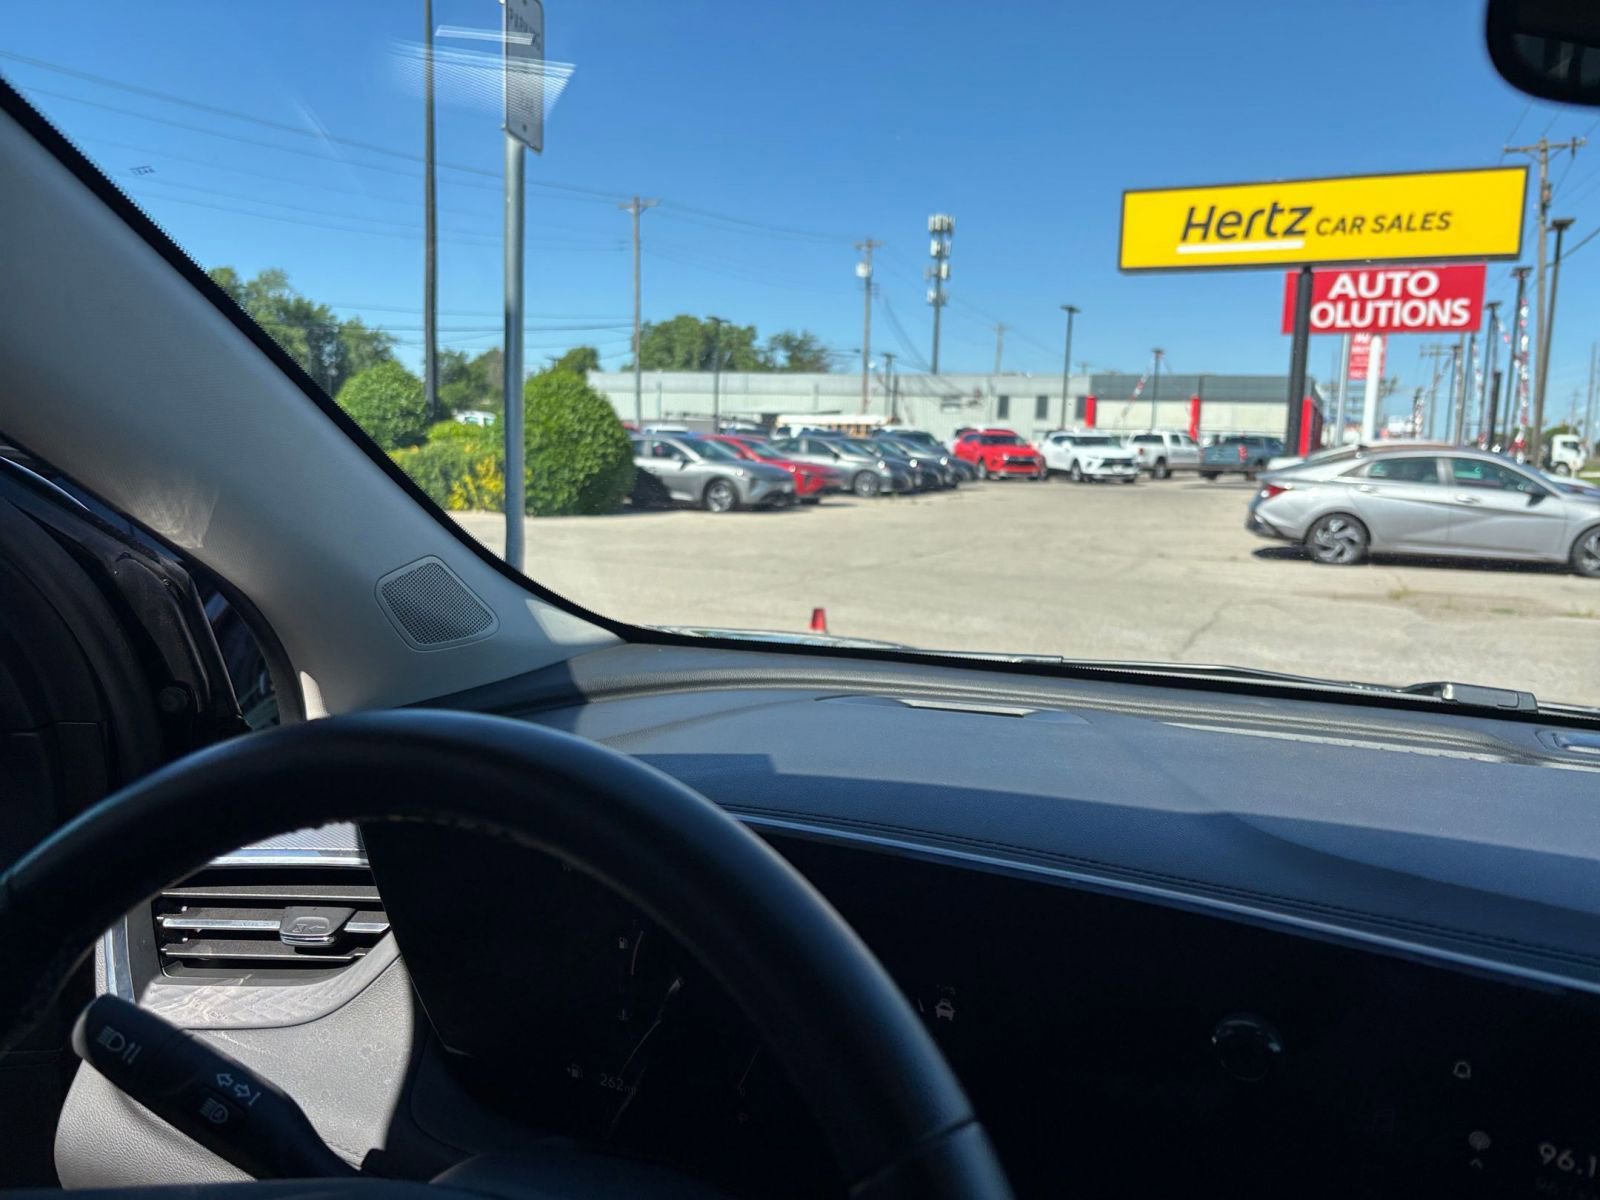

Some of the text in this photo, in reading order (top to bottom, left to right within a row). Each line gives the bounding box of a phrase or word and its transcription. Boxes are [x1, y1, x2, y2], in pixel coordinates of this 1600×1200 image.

[1180, 201, 1452, 241] Hertz CAR SALES
[1327, 270, 1440, 299] AUTO
[1309, 298, 1471, 329] OLUTIONS
[1538, 1142, 1598, 1178] 96.1
